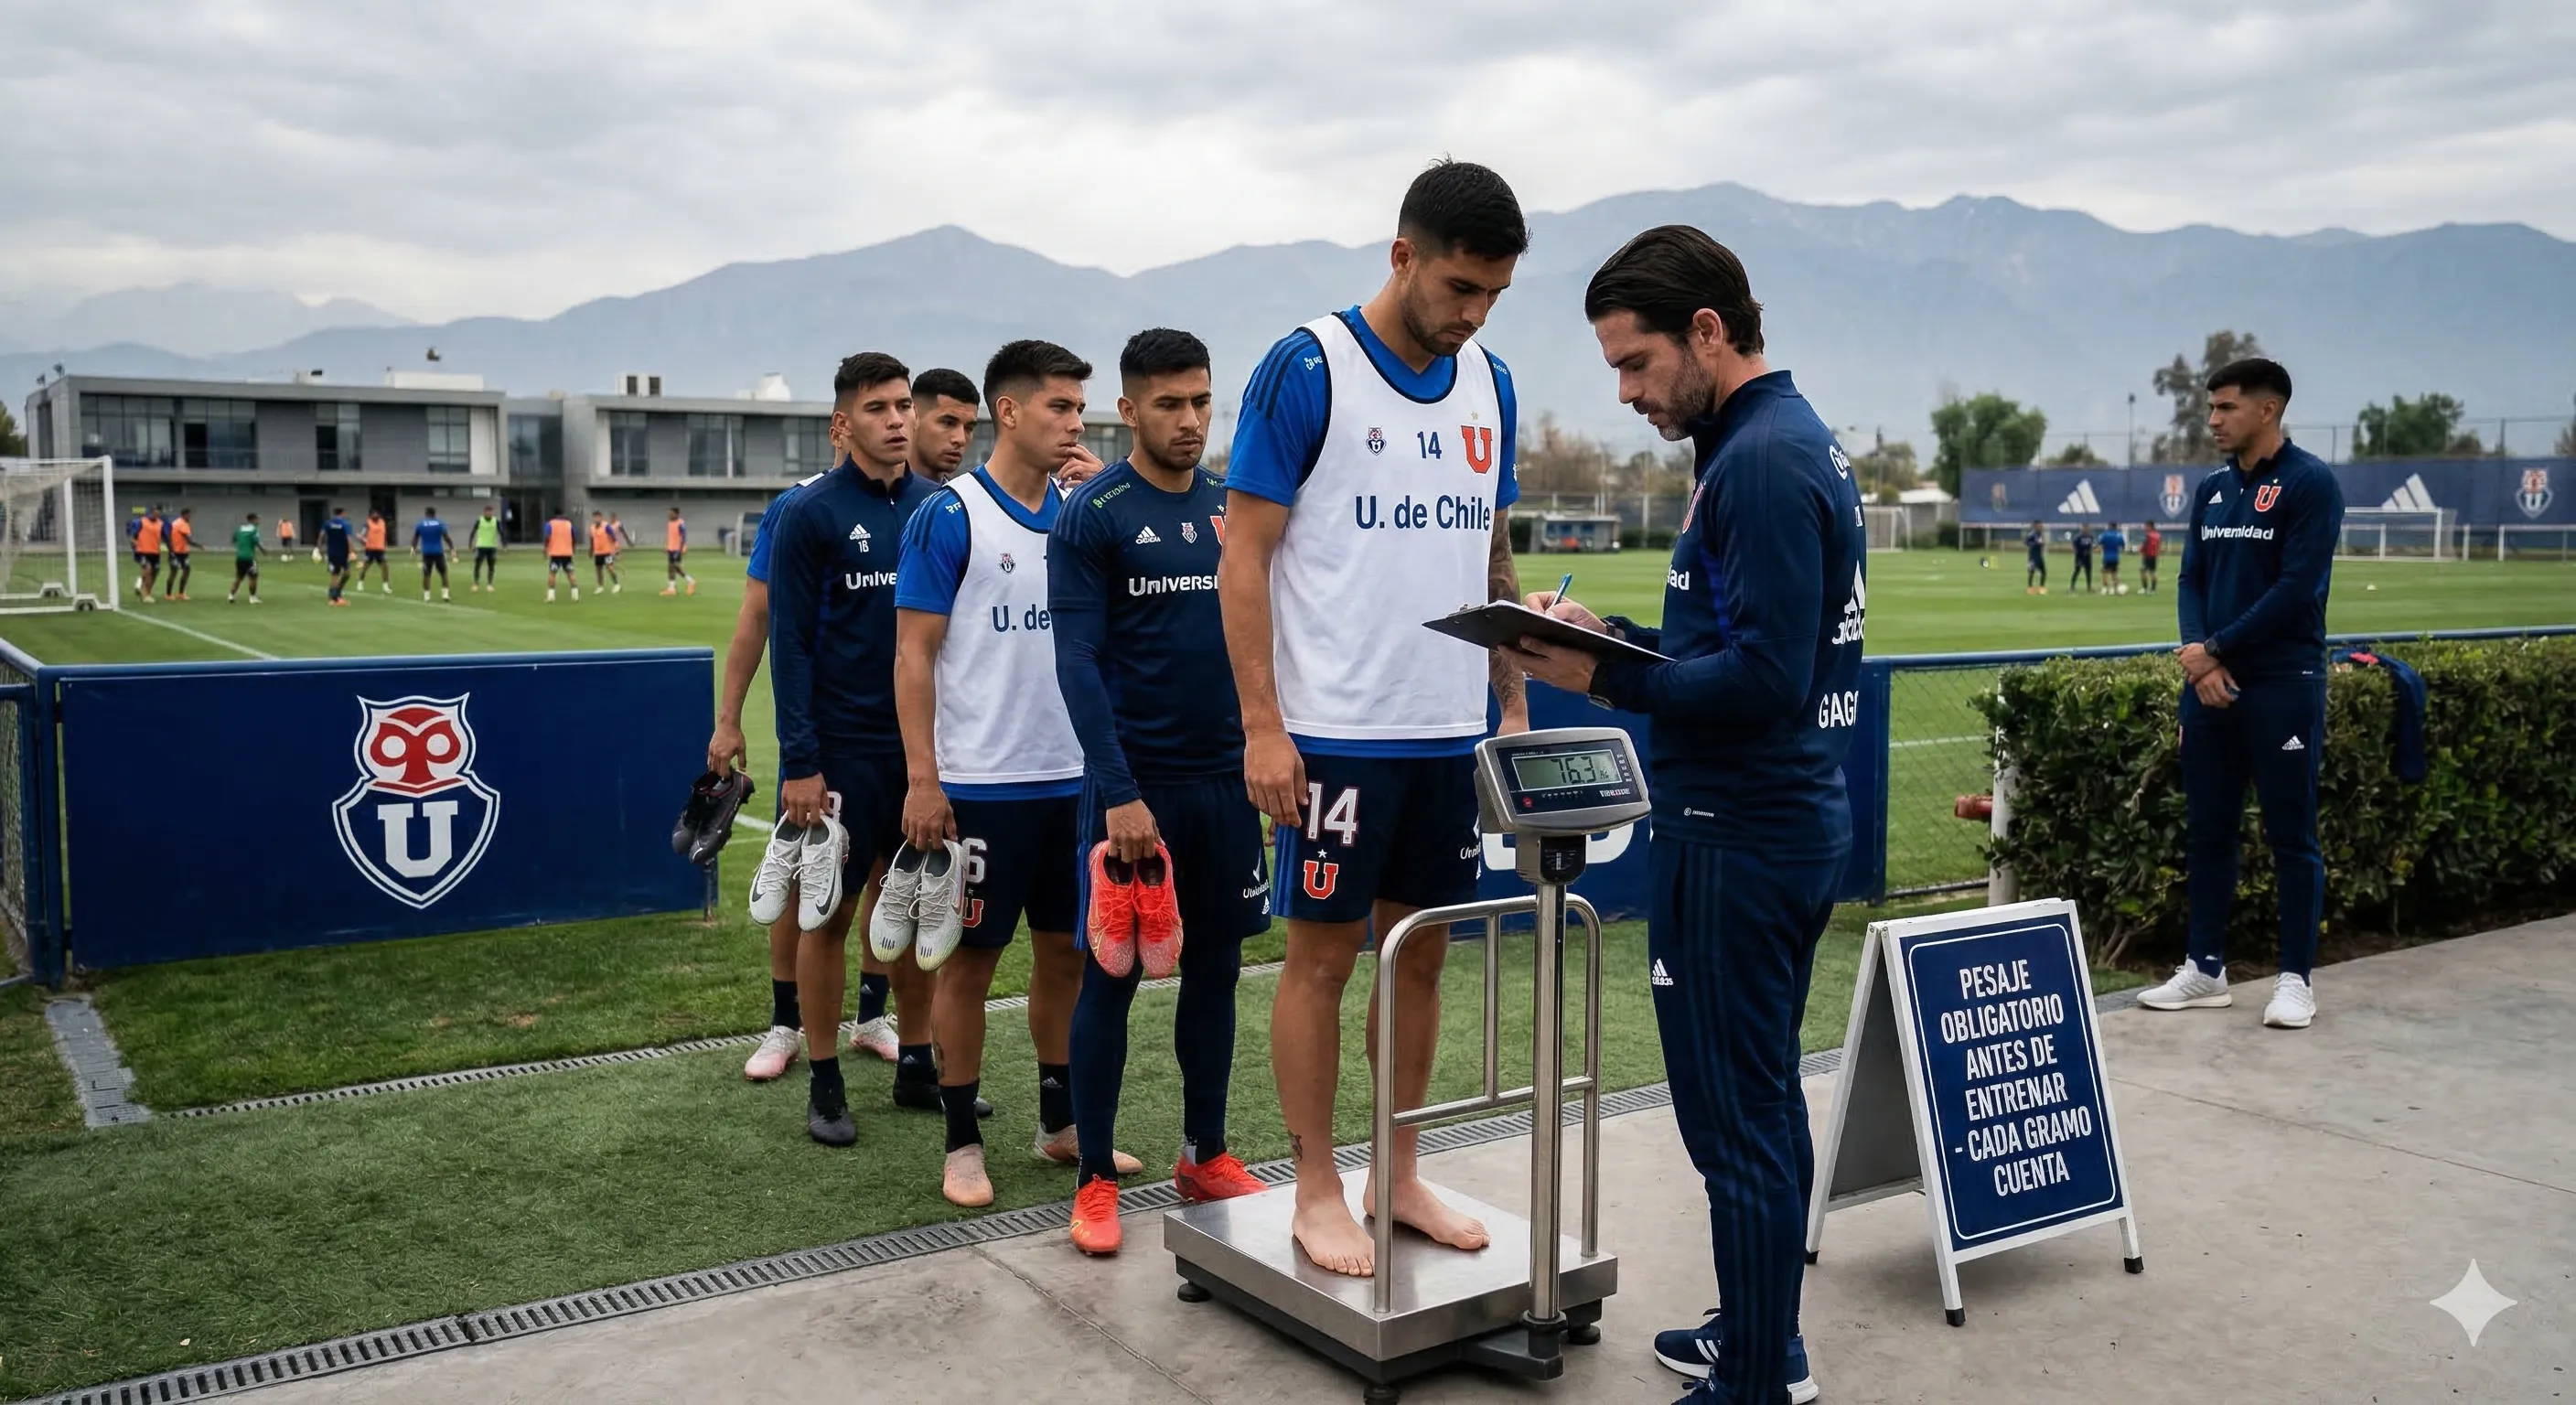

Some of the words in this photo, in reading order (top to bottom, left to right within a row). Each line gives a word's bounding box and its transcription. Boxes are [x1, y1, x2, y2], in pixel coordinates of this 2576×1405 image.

[1417, 431, 1443, 459] 14
[1461, 424, 1493, 474] U
[1355, 495, 1385, 531] U.
[1393, 495, 1428, 530] de
[1435, 495, 1491, 531] Chile
[2255, 486, 2281, 512] U
[992, 606, 1017, 633] U.
[1024, 604, 1051, 631] de
[1308, 782, 1358, 844] 14
[377, 800, 458, 878] U
[1303, 860, 1339, 900] U
[1959, 959, 2032, 1000] PESAJE
[1940, 993, 2065, 1044] OBLIGATORIO
[1965, 1039, 2028, 1080] ANTES
[2030, 1034, 2058, 1068] DE
[1964, 1071, 2069, 1121] ENTRENAR
[1967, 1121, 2022, 1163] CADA
[2023, 1105, 2092, 1151] GRAMO
[1992, 1151, 2071, 1197] CUENTA
